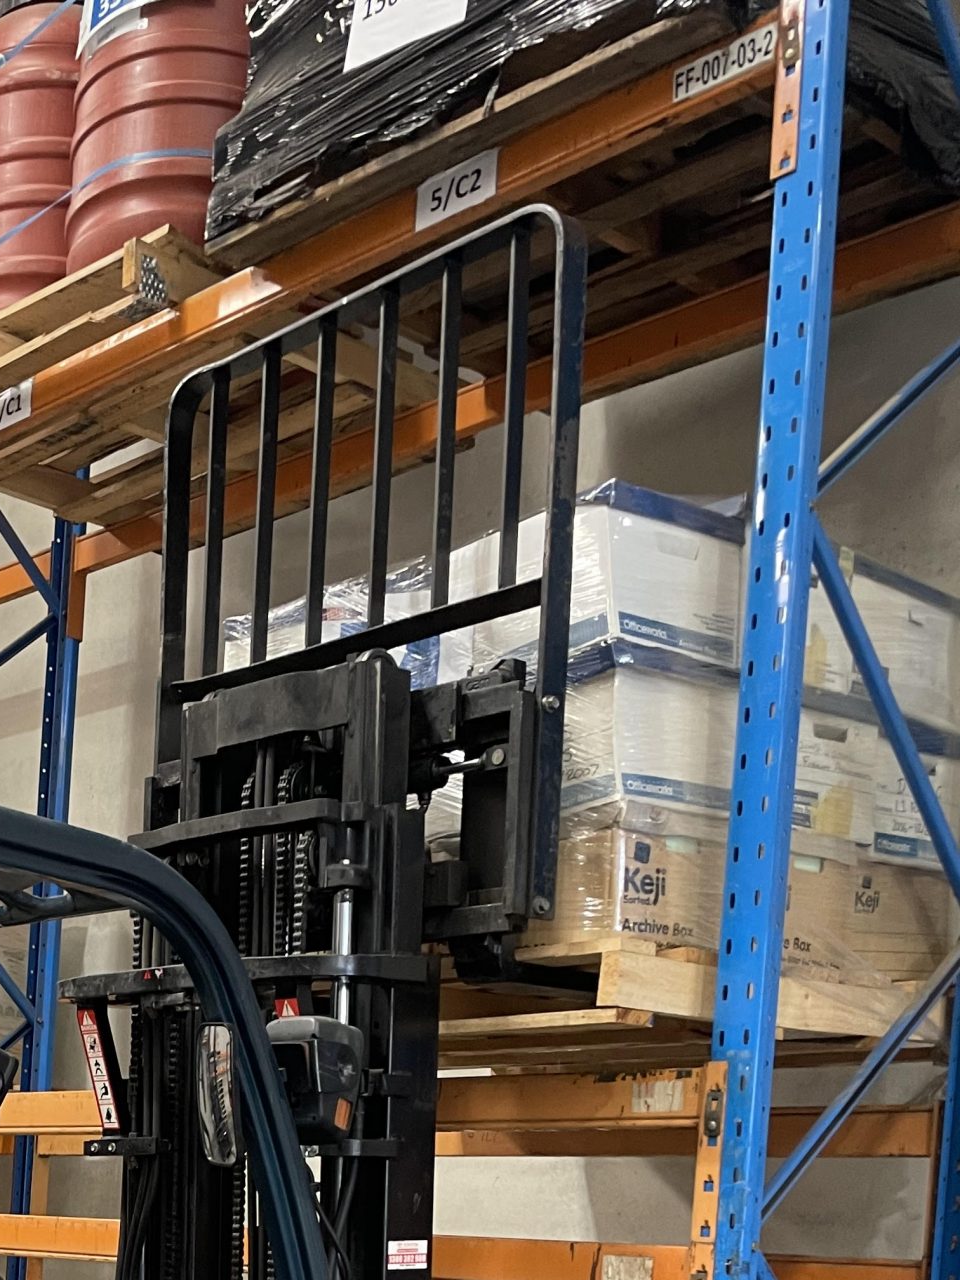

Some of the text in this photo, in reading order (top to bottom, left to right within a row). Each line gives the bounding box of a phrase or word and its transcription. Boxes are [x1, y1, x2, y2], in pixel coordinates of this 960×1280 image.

[675, 30, 773, 98] FF-007-03-2
[430, 169, 482, 212] 5/C2
[624, 867, 666, 906] Keji
[855, 890, 880, 913] Keji
[622, 918, 694, 937] Archive Box
[793, 937, 811, 953] Box
